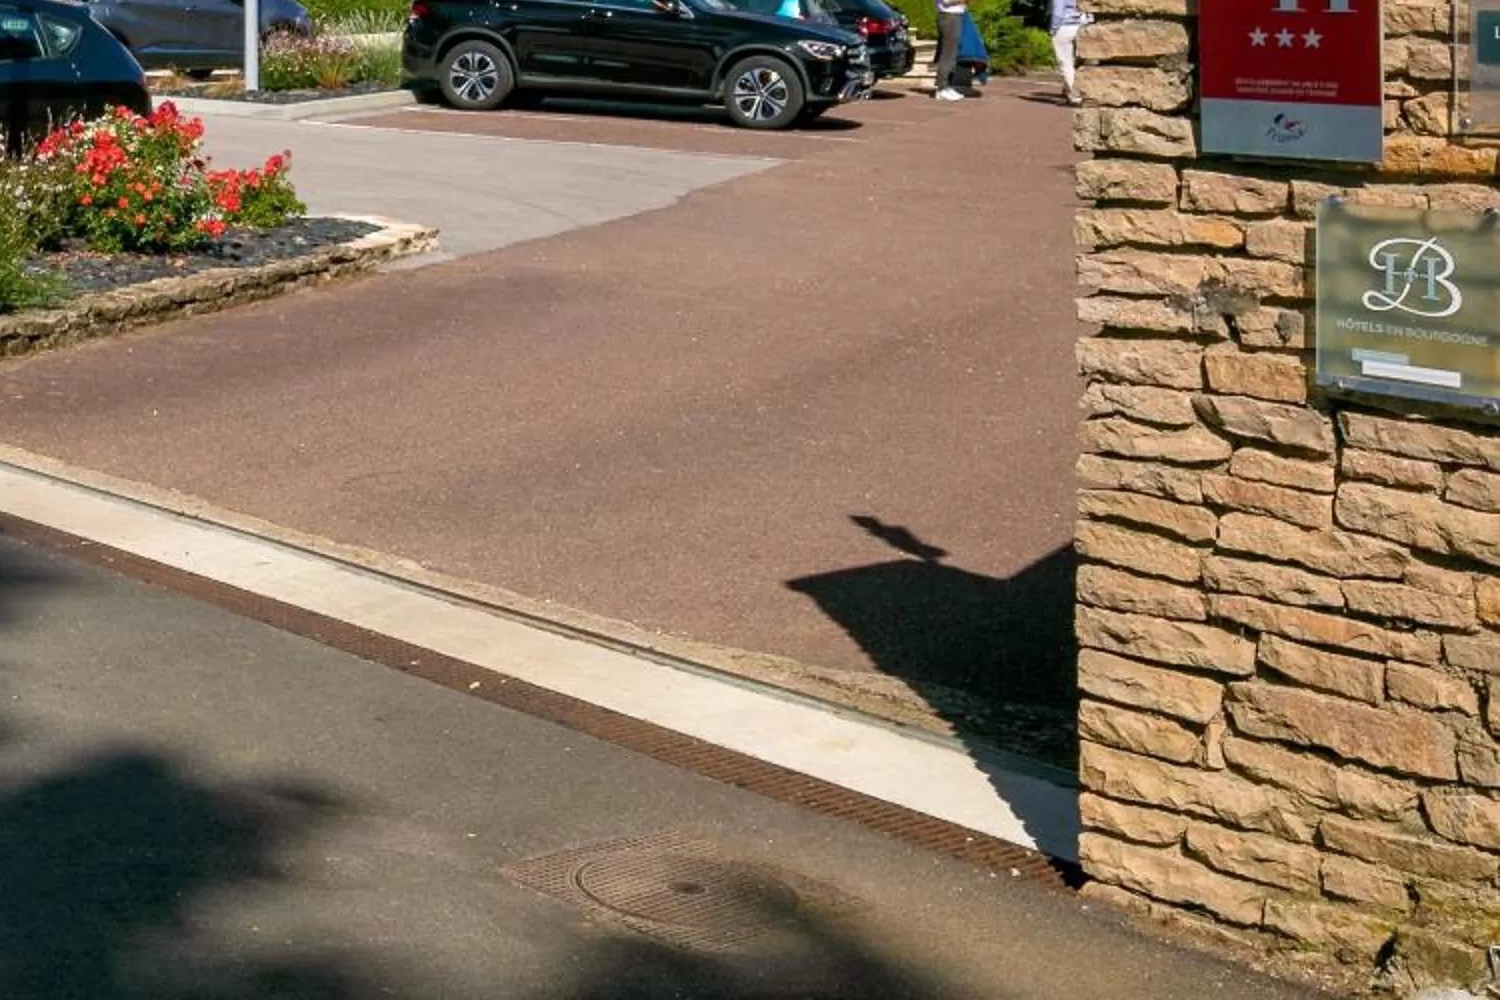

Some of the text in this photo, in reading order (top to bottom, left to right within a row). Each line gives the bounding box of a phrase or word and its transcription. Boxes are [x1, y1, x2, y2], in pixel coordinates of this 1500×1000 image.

[1336, 317, 1489, 347] HÔTELS EN BOURGOGNE
